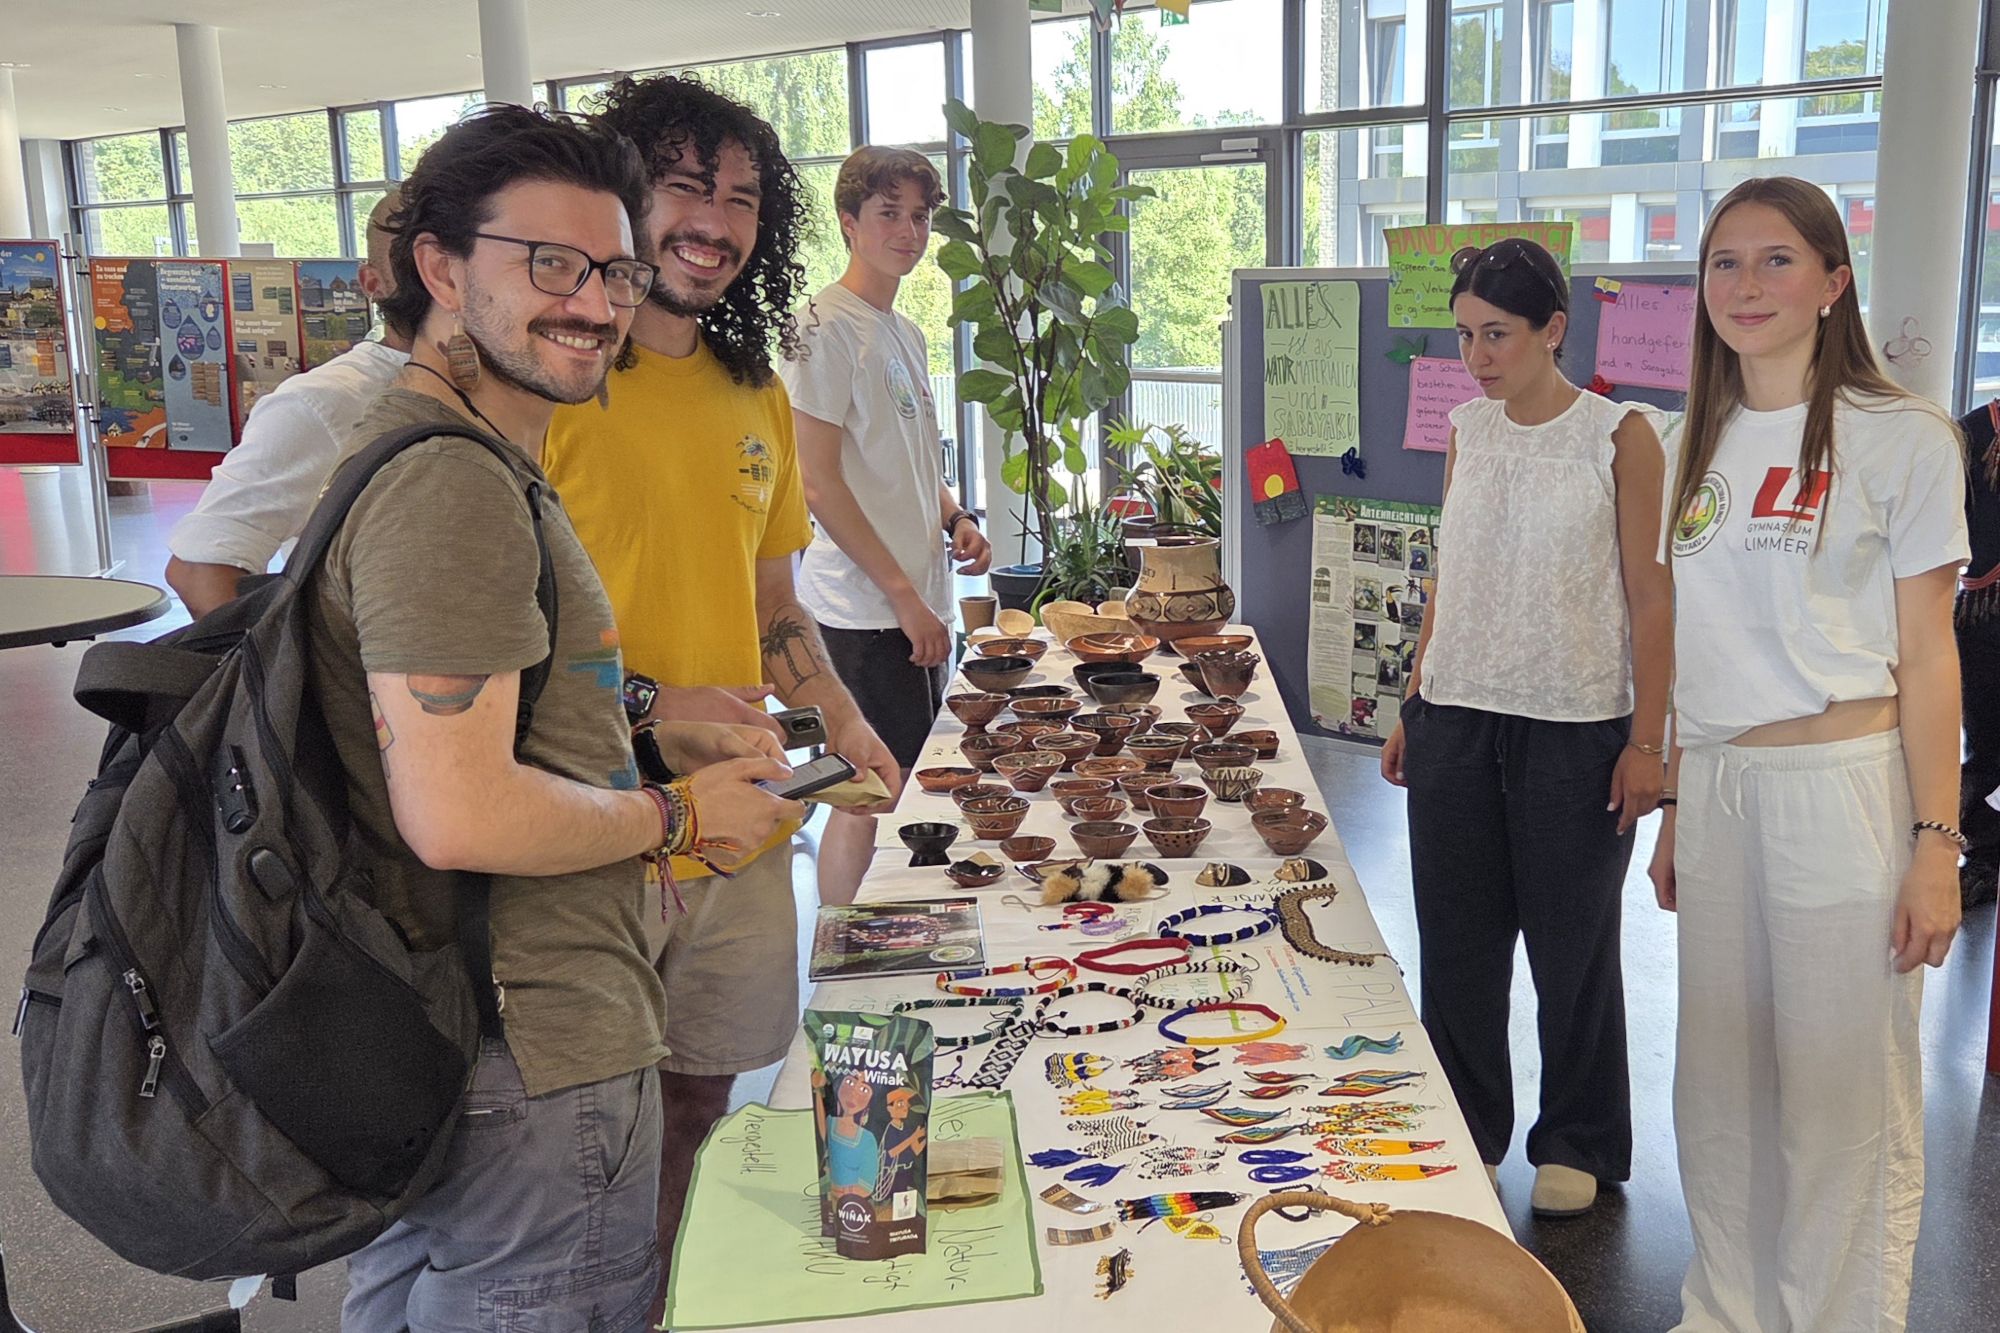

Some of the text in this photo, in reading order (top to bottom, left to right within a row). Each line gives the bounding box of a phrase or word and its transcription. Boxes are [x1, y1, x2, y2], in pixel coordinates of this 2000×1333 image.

[1266, 284, 1336, 330] ALLES
[1615, 292, 1660, 312] Alles
[1288, 385, 1317, 410] und
[1273, 407, 1357, 441] SARAYAKU
[1430, 514, 1441, 526] DE
[1746, 522, 1812, 537] GYMNASIUM
[1744, 537, 1809, 556] LIMMER
[824, 1043, 908, 1072] WAYUSA
[863, 1069, 905, 1087] Wiñak
[838, 1208, 872, 1224] WIÑAK
